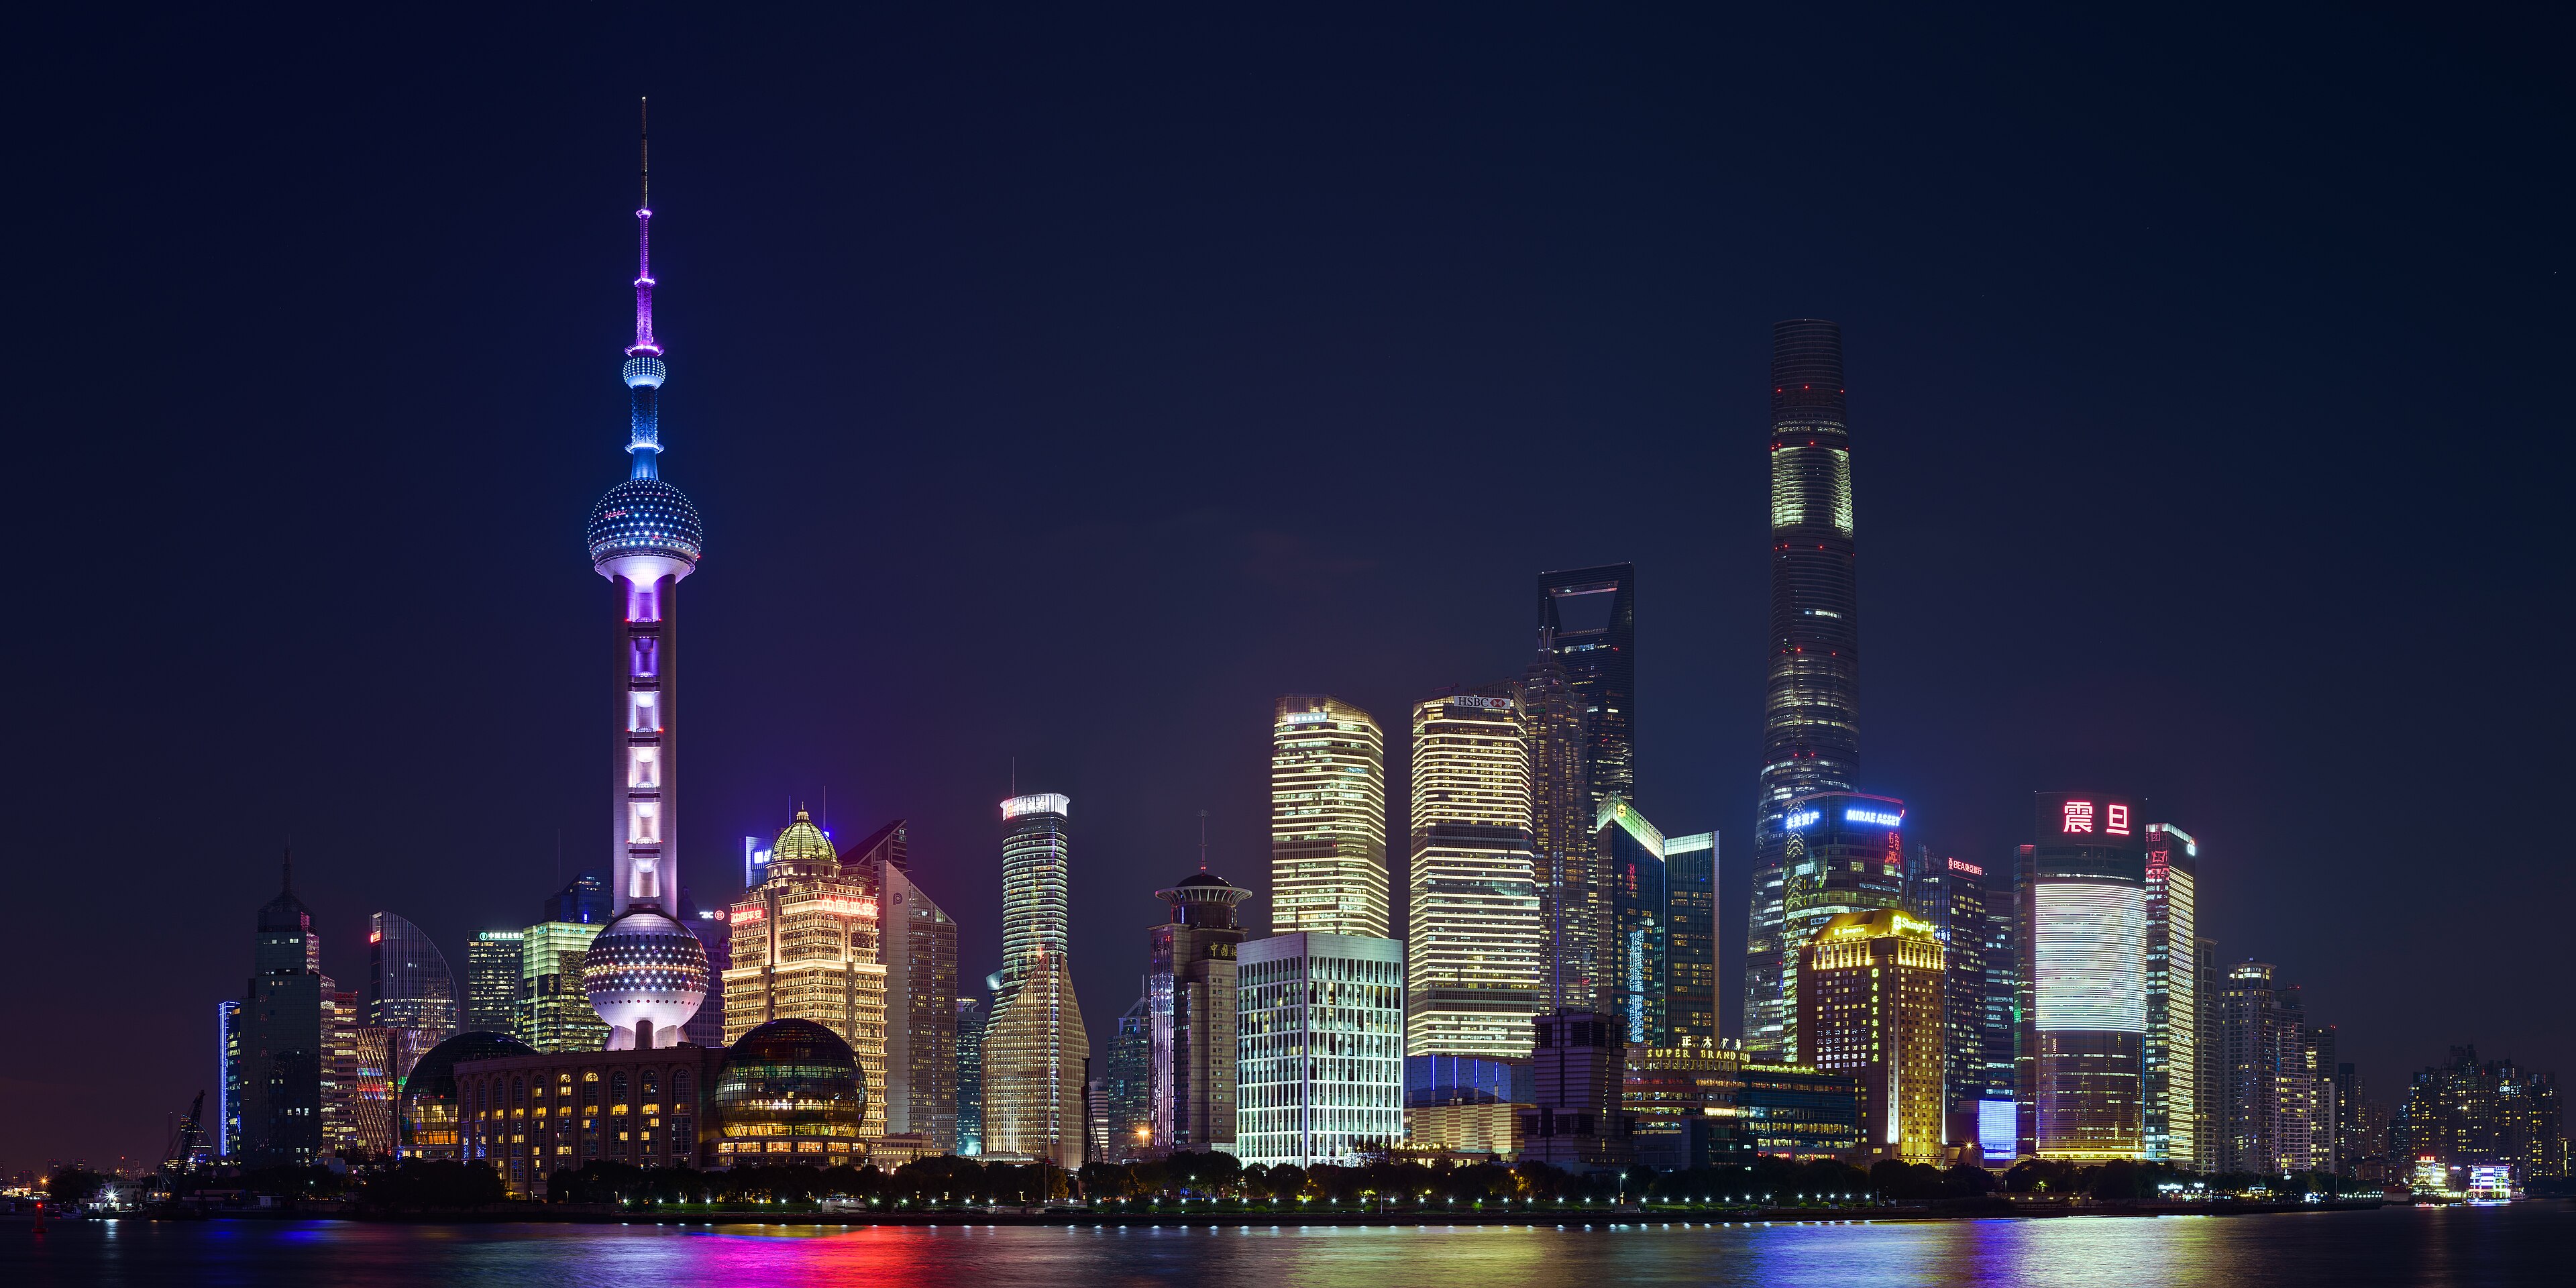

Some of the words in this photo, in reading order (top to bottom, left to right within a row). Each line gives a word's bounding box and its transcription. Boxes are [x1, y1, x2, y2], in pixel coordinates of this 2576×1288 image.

[1458, 697, 1489, 708] HSBC
[1847, 810, 1876, 824] MIRAE
[1876, 814, 1900, 826] ASSET
[2063, 802, 2130, 835] 震旦
[1953, 860, 1965, 871] BEA
[822, 898, 874, 916] 中国平安
[733, 910, 762, 923] 中国平安
[537, 926, 547, 935] AZIA
[1901, 917, 1935, 934] Shangri-La
[1871, 981, 1879, 1063] 香格里拉大酒店
[1647, 1049, 1690, 1058] SUPER
[1701, 1049, 1736, 1061] BRAND
